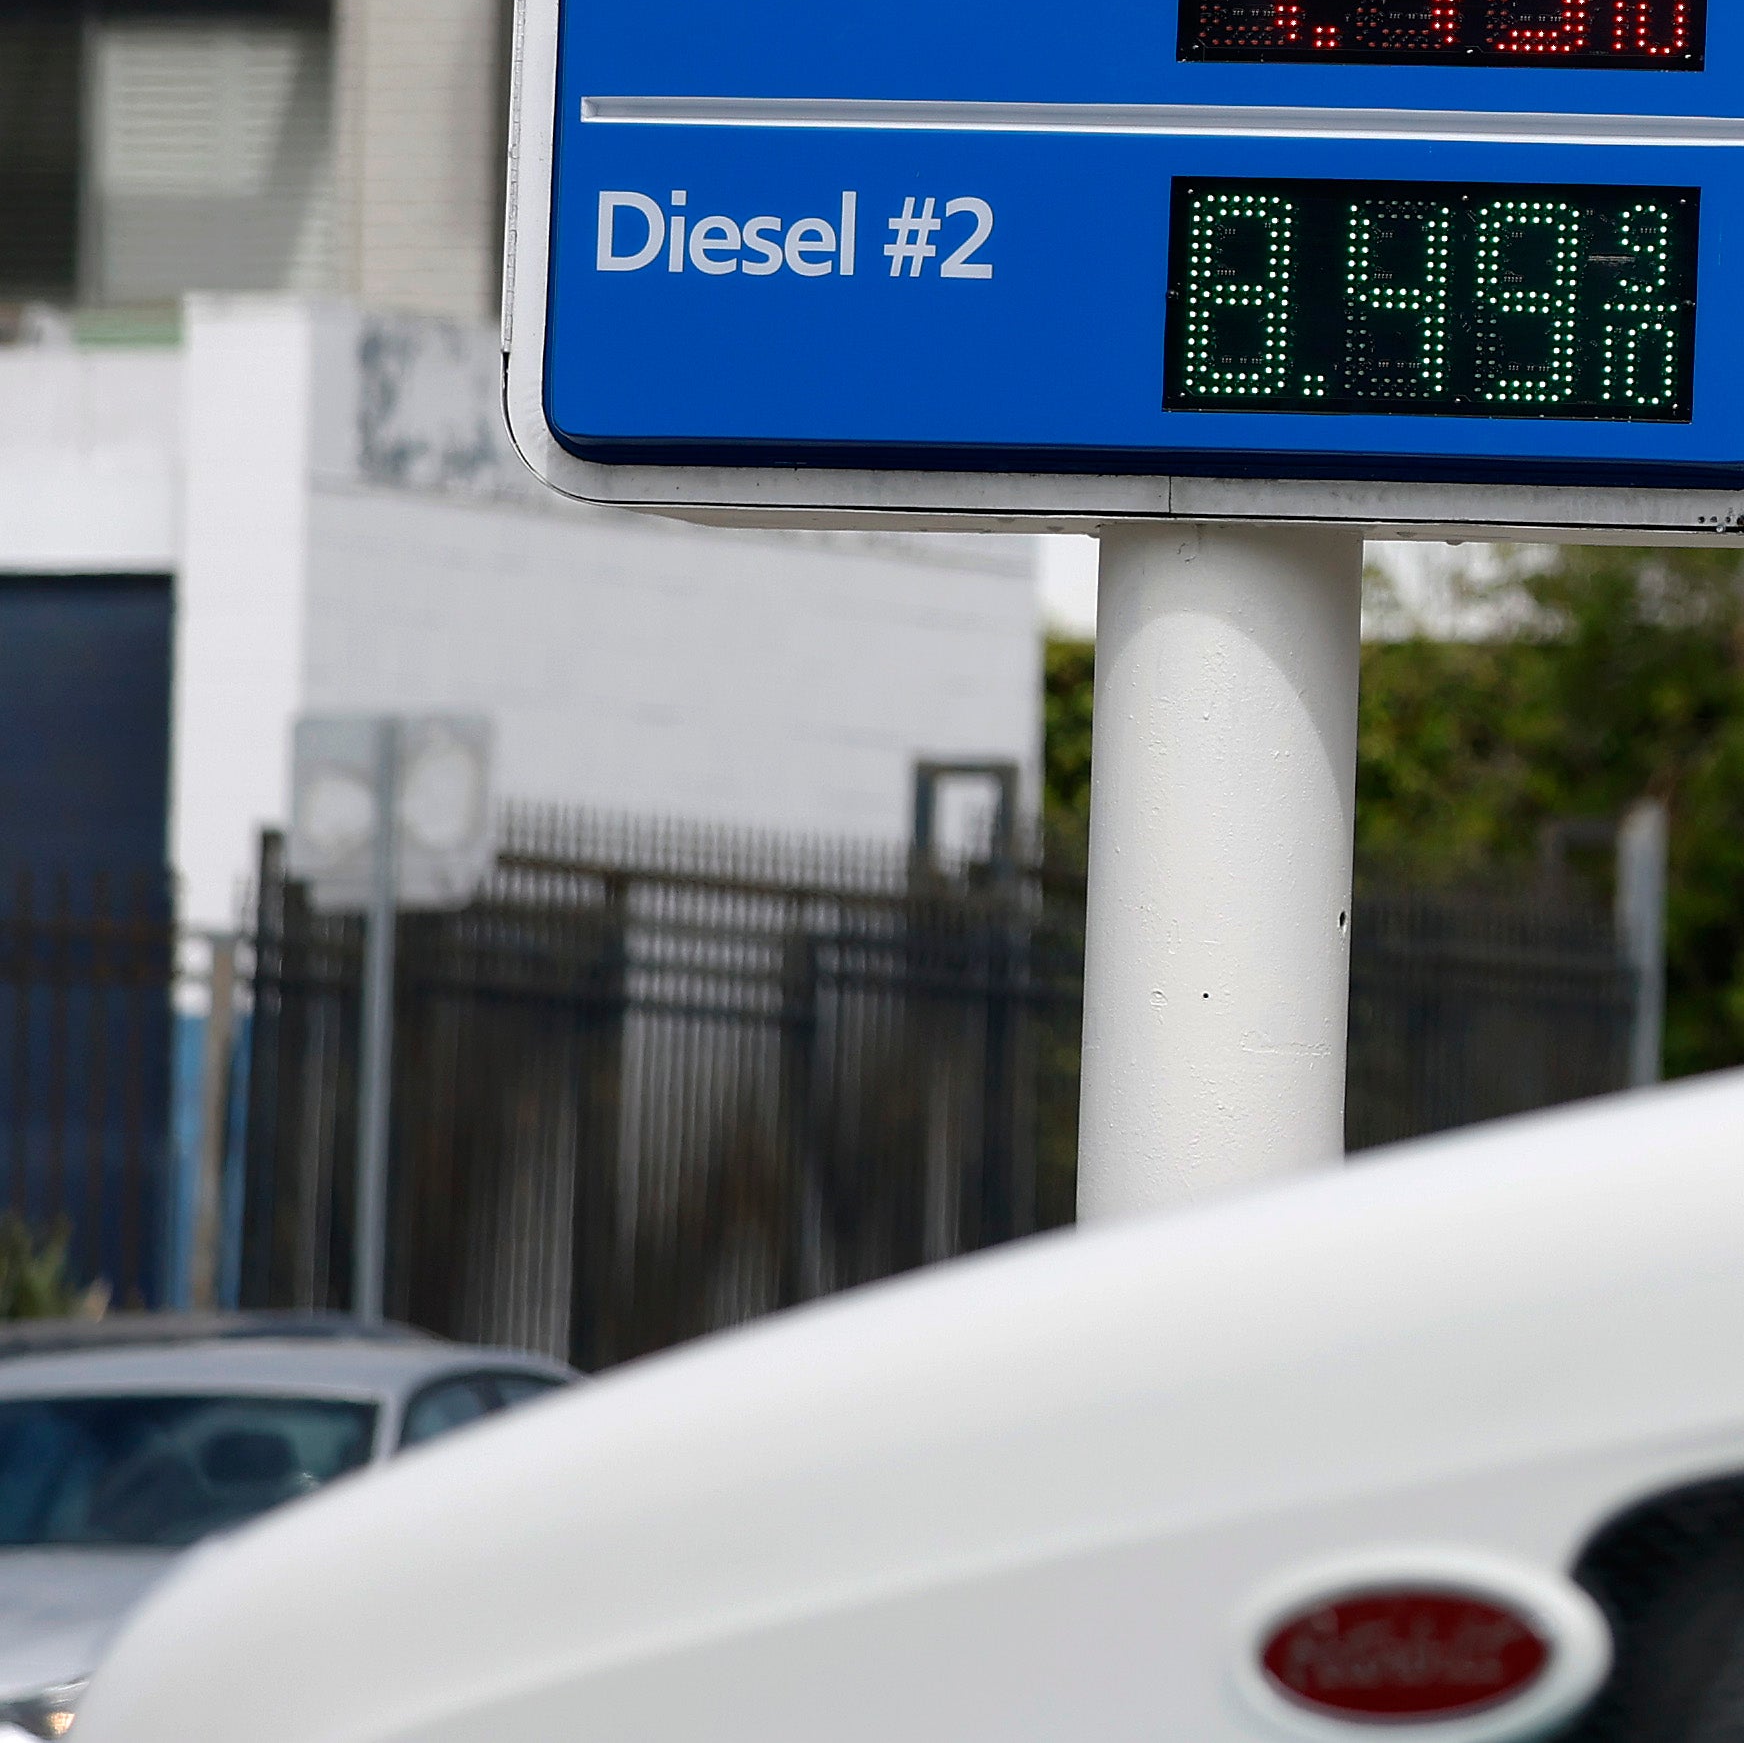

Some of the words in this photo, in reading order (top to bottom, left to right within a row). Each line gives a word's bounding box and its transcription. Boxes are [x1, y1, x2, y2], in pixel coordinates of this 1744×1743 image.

[596, 189, 859, 280] Diesel
[883, 196, 995, 281] #2
[1184, 194, 1581, 403] 8.49
